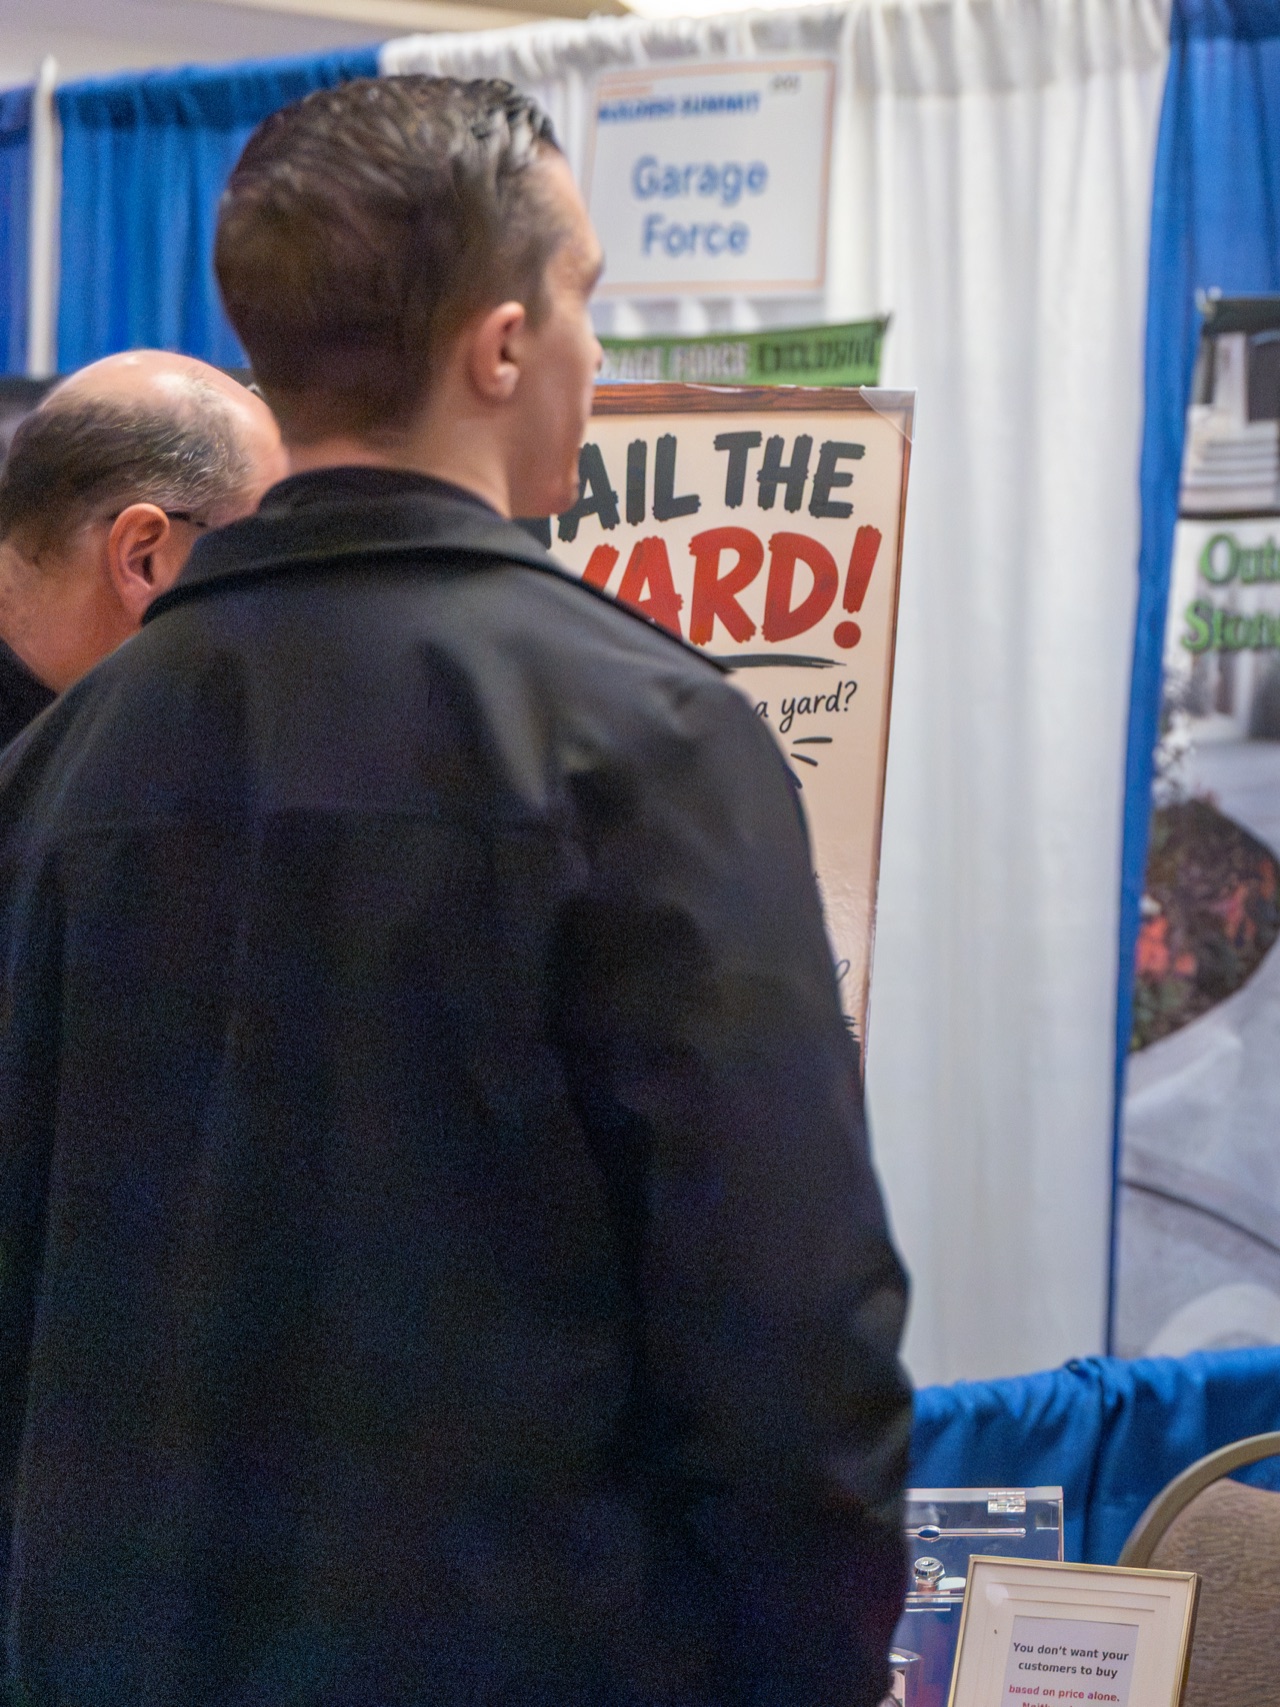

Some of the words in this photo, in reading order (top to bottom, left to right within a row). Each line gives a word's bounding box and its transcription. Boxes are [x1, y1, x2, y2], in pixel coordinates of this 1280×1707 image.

[632, 154, 769, 206] Garage
[642, 213, 750, 257] Force
[522, 432, 701, 551] AIL
[713, 430, 866, 519] THE
[755, 701, 769, 718] a
[779, 680, 858, 734] yard?
[1013, 1642, 1034, 1653] You
[1070, 1649, 1099, 1659] want
[1102, 1651, 1129, 1661] your
[1018, 1662, 1077, 1674] customers
[1080, 1666, 1092, 1675] to
[1096, 1667, 1118, 1679] buy
[1009, 1684, 1040, 1695] based
[1042, 1688, 1055, 1696] on
[1058, 1689, 1085, 1699] price
[1087, 1691, 1120, 1702] alone.
